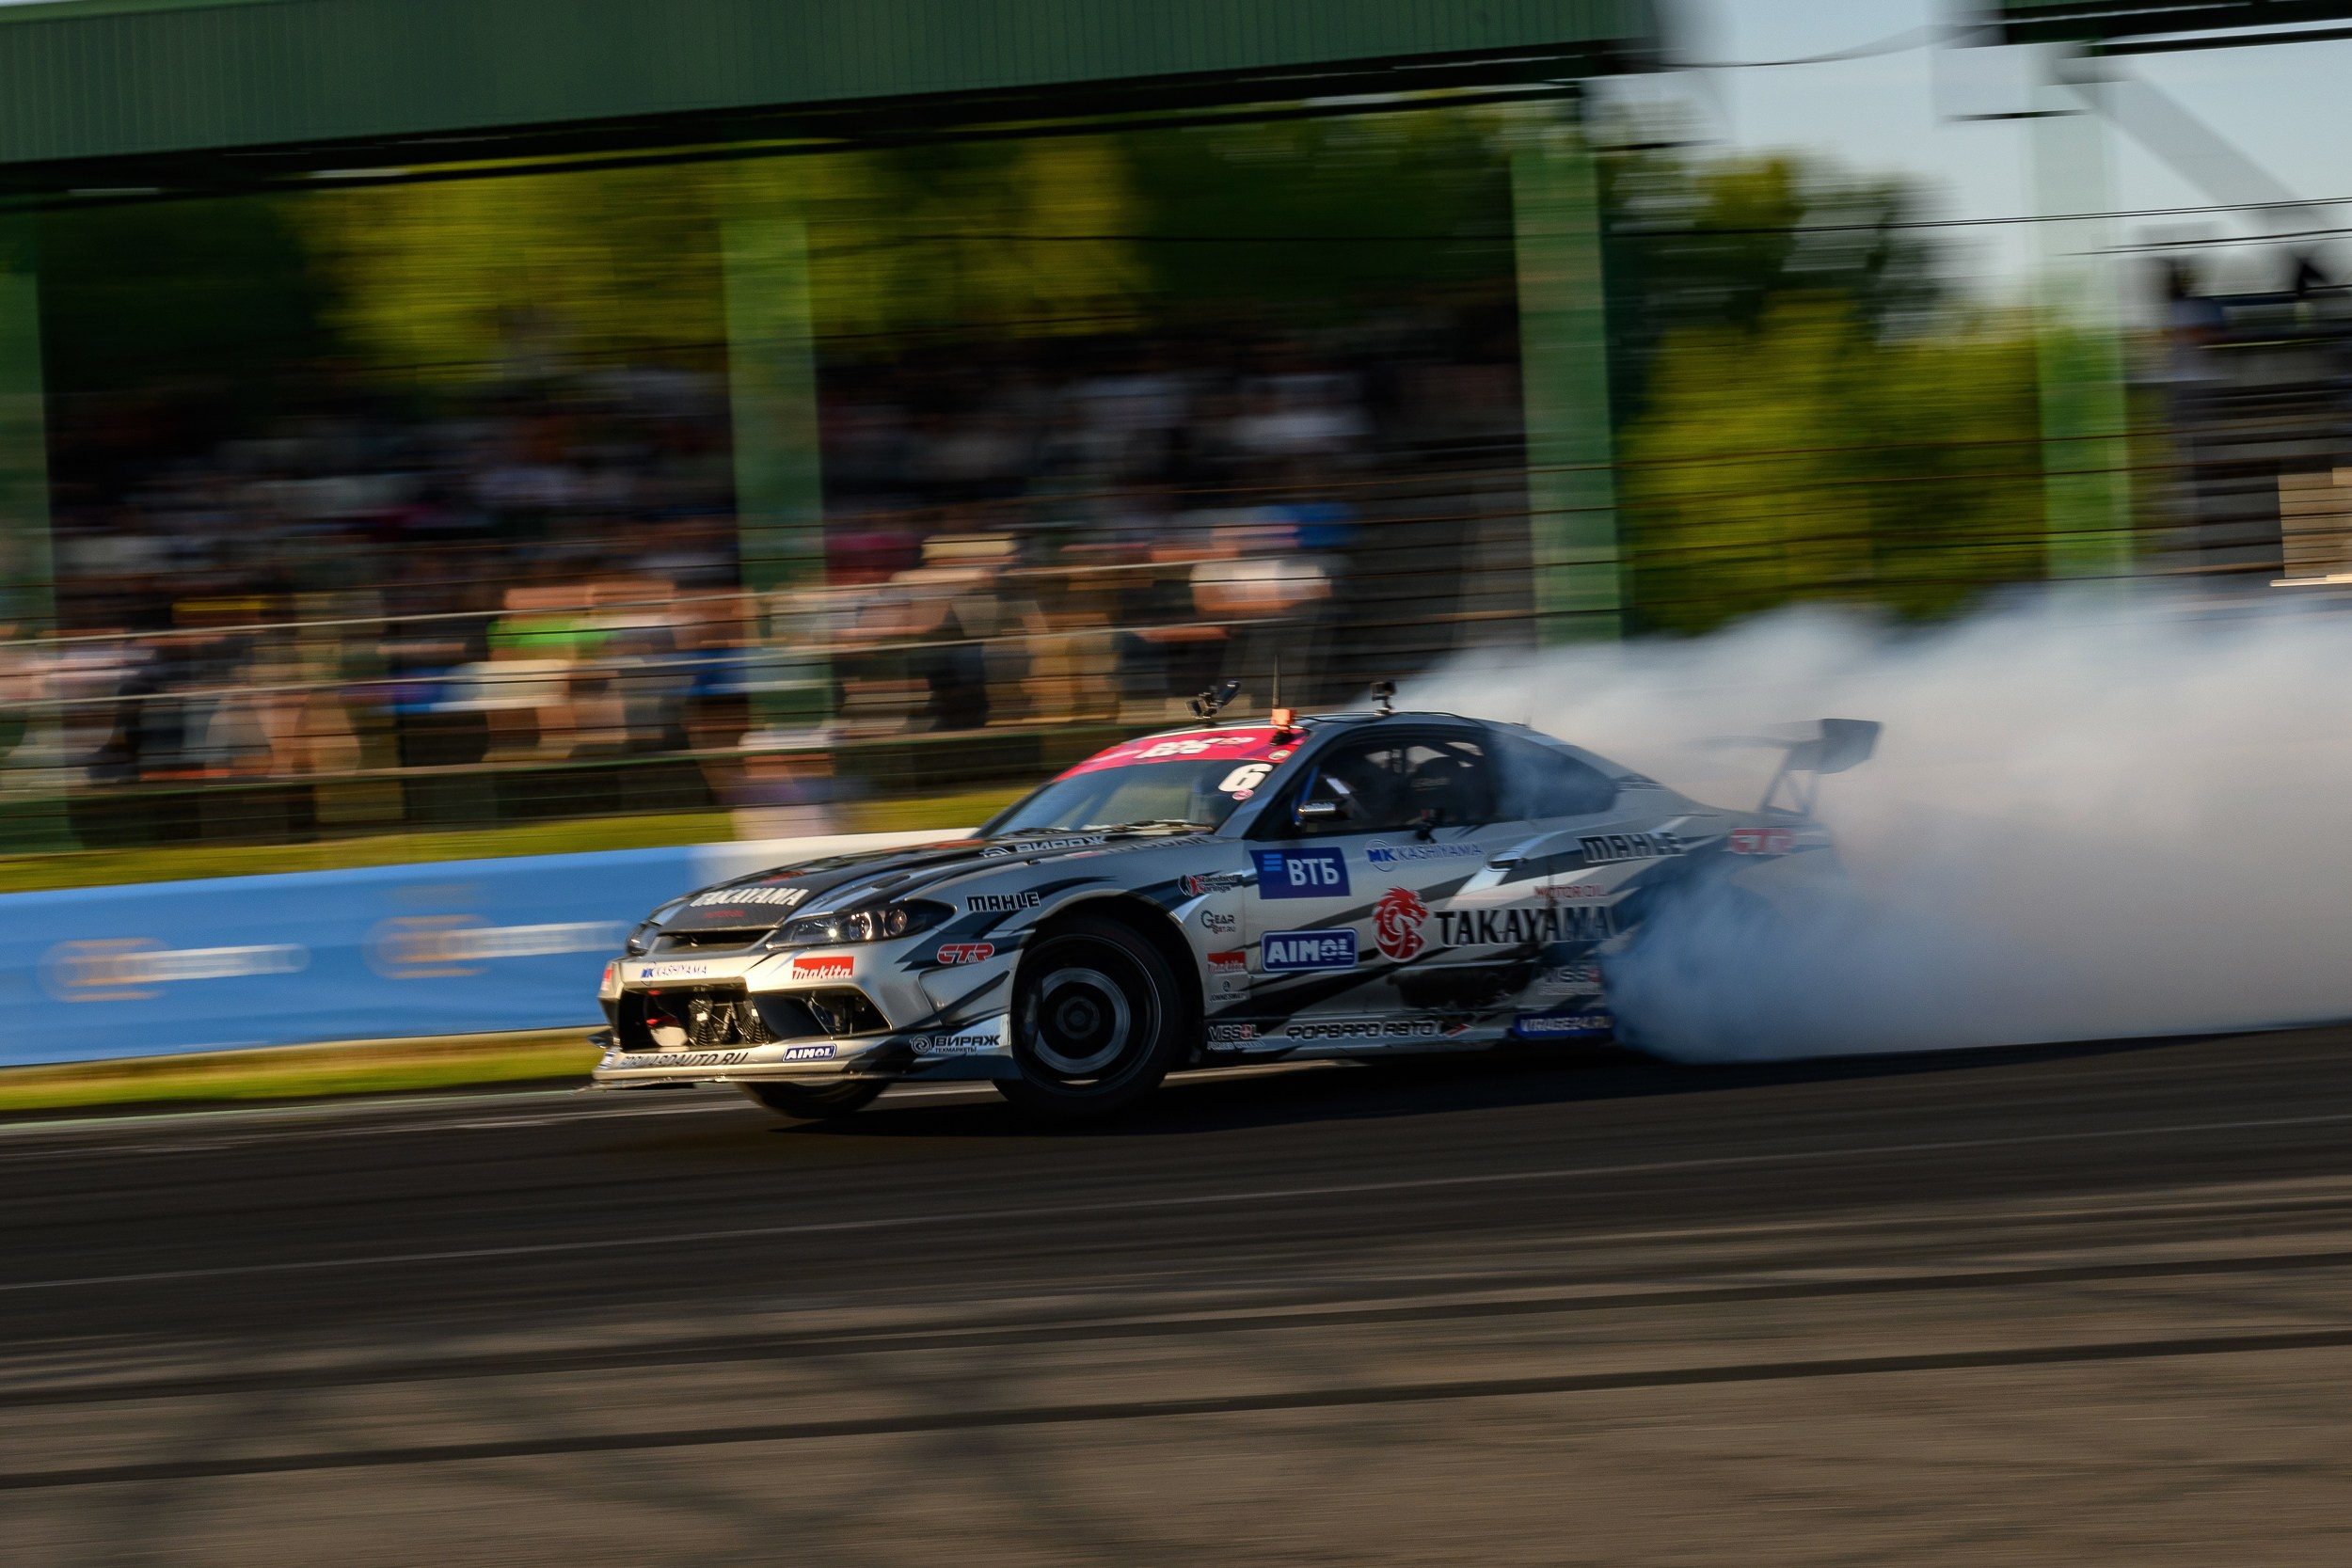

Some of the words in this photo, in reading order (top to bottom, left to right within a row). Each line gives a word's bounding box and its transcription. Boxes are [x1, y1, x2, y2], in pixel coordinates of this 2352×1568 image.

[1218, 763, 1273, 792] 6
[1288, 858, 1341, 886] ВТБ
[966, 892, 1041, 913] MAHLE
[1435, 906, 1614, 946] TAKAYAMA
[937, 942, 994, 964] GTR
[1266, 938, 1354, 963] AIMOL
[792, 965, 851, 979] makita
[935, 1034, 1001, 1046] ВИРАЖ
[785, 1047, 832, 1059] AIMOL
